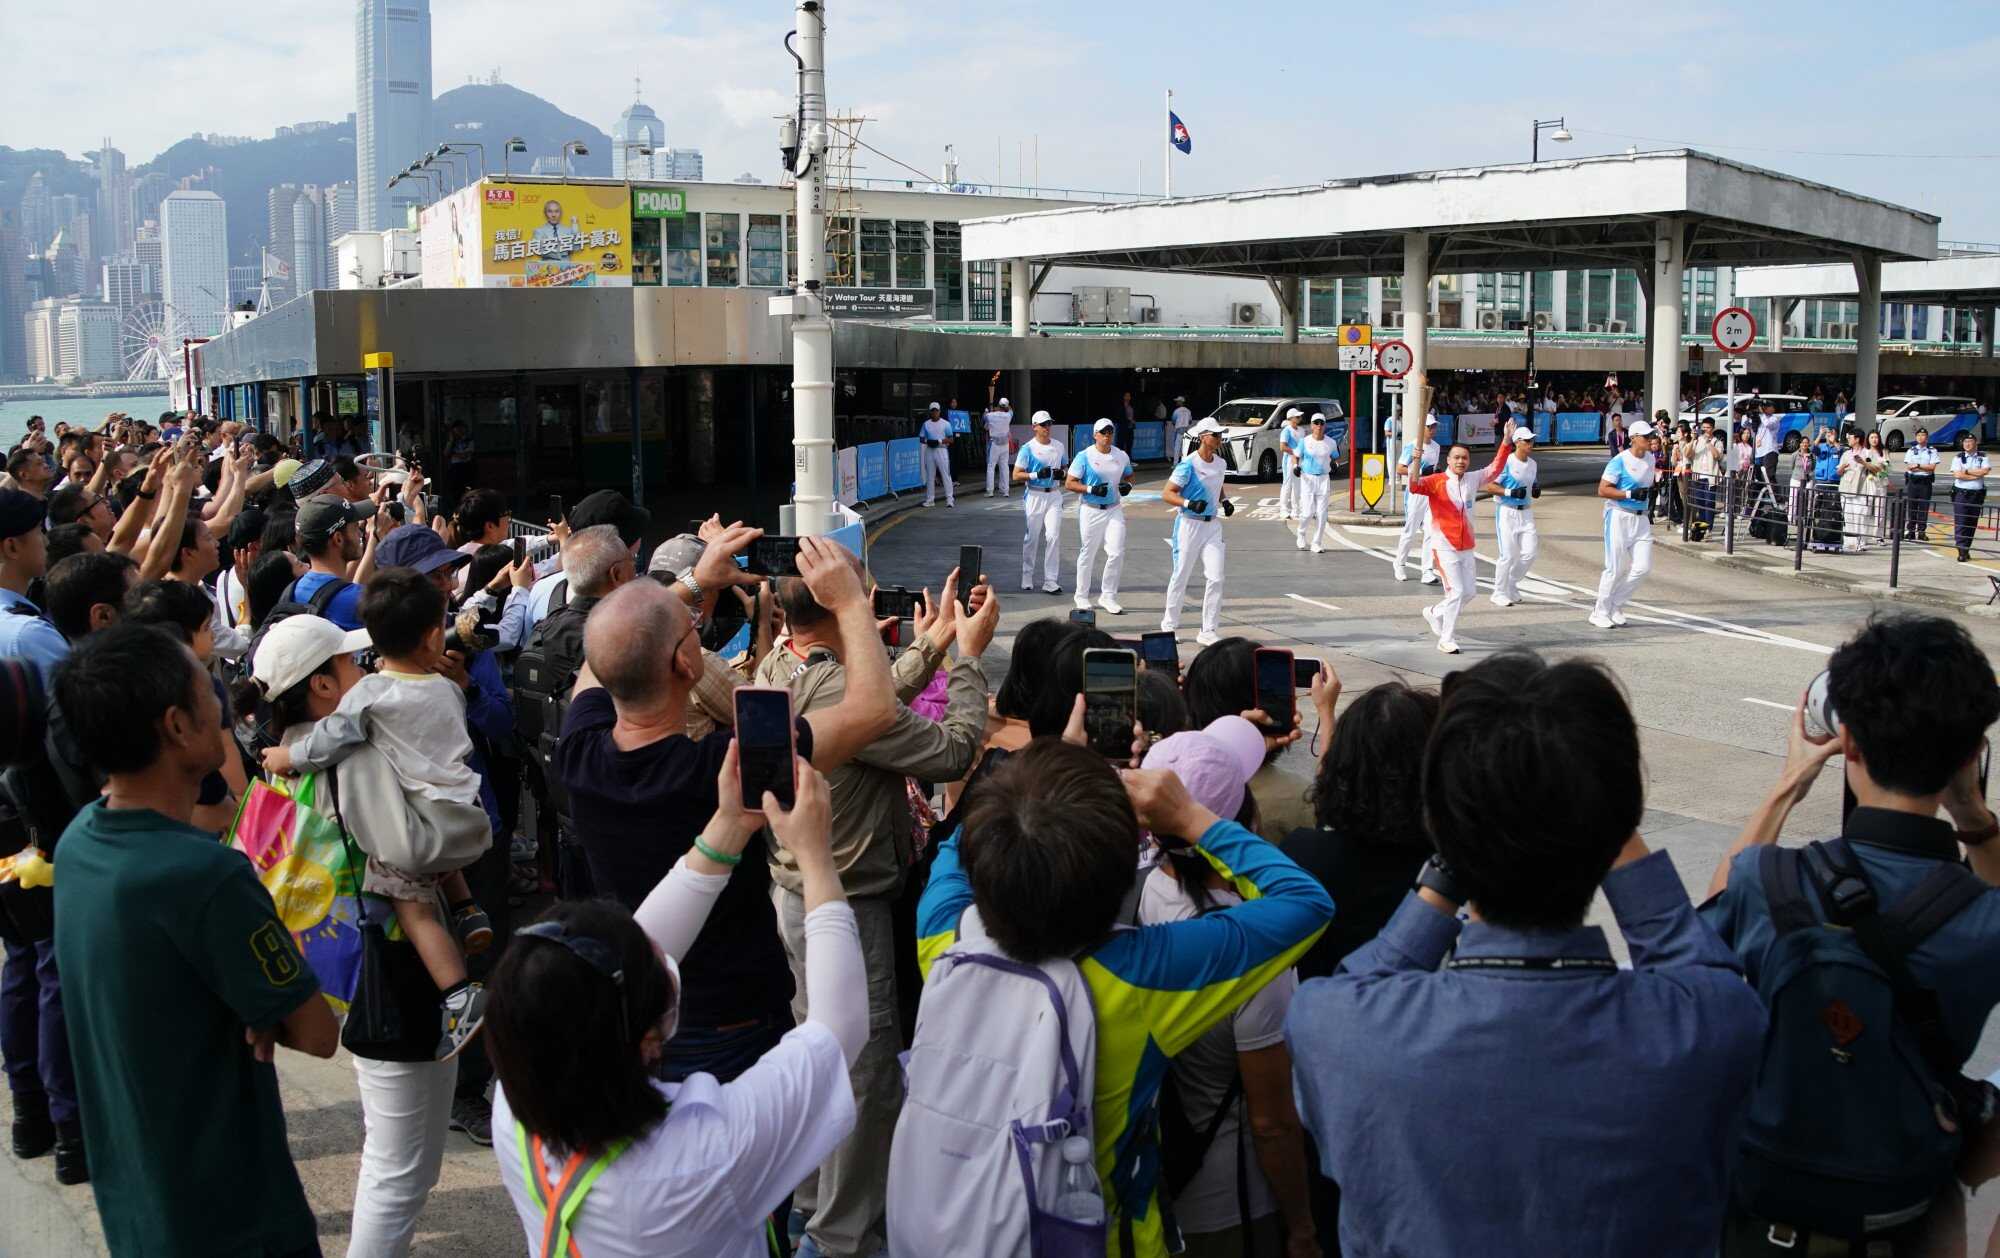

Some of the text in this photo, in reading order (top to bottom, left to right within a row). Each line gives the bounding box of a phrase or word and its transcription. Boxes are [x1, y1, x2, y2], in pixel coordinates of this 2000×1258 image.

[638, 192, 682, 211] POAD
[834, 293, 859, 301] Water
[860, 293, 876, 301] Tour
[1726, 326, 1732, 335] 2
[1358, 346, 1365, 355] 7
[1358, 360, 1369, 369] 12
[954, 418, 967, 431] 24
[249, 920, 300, 986] 8
